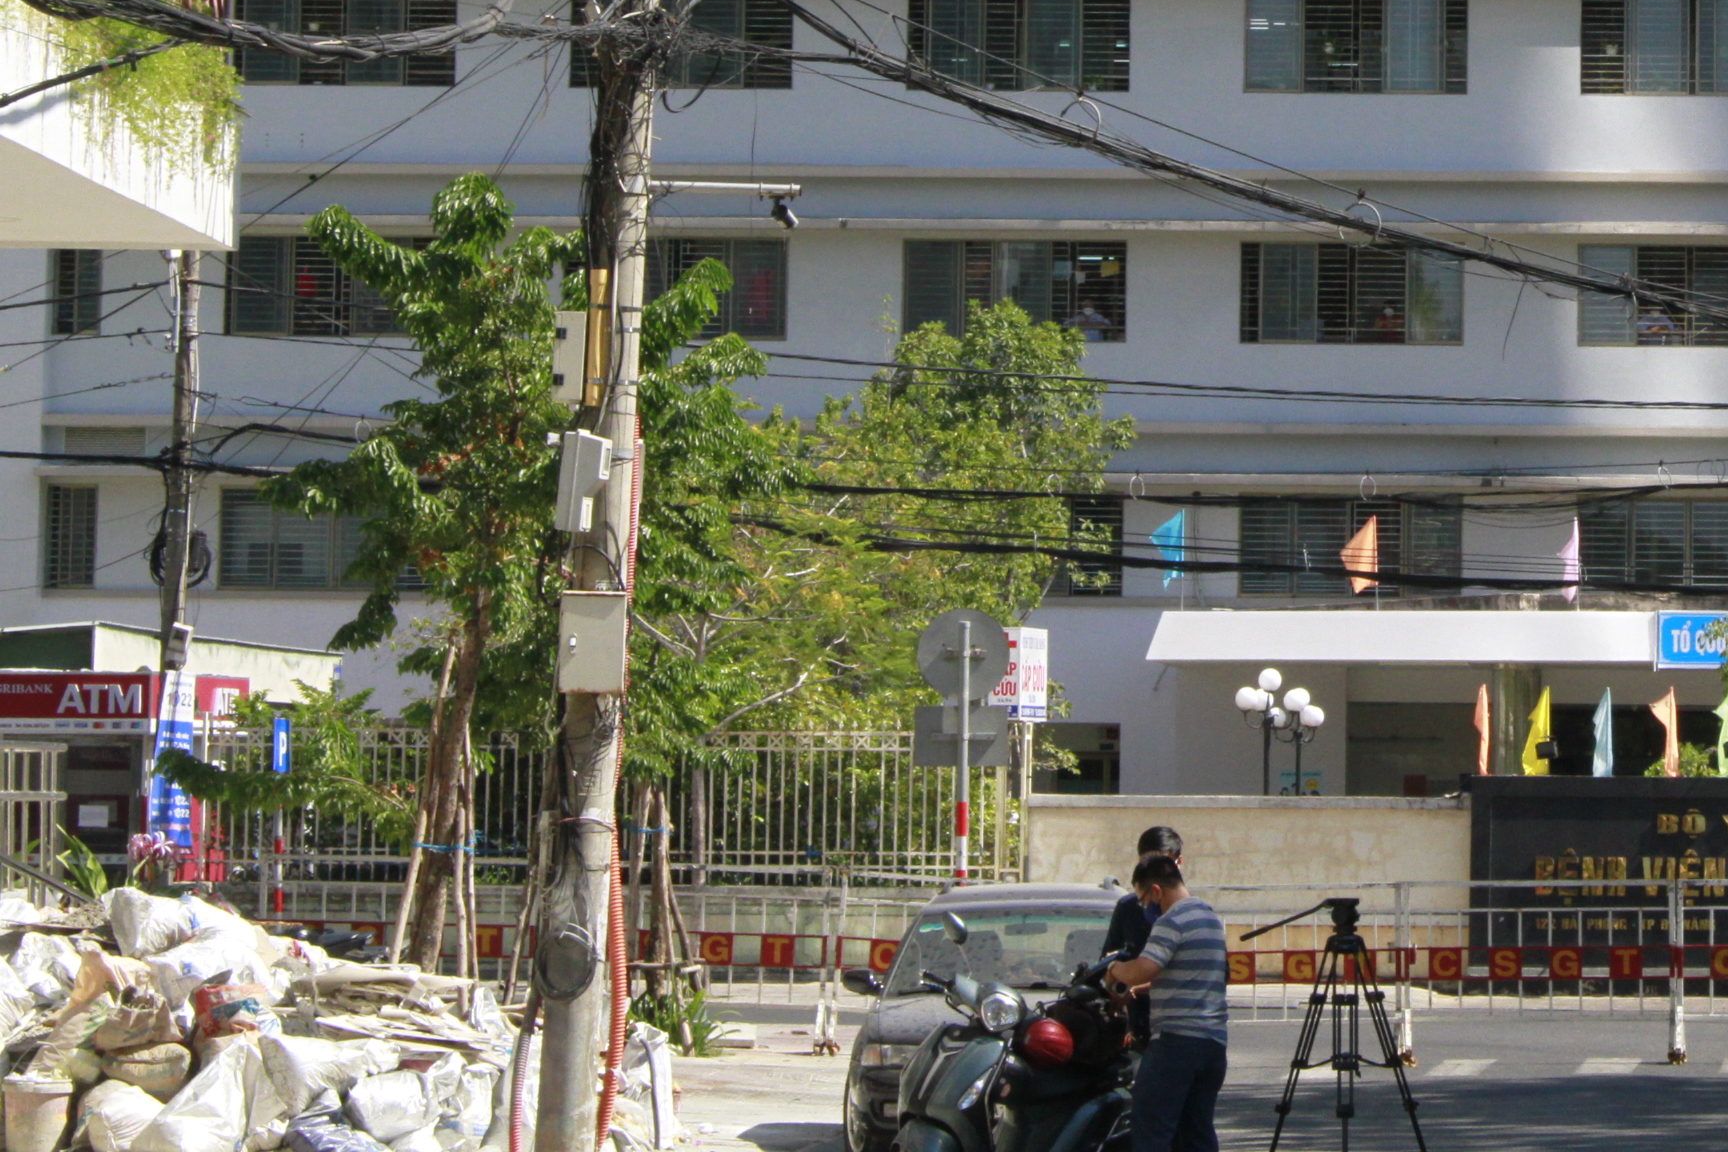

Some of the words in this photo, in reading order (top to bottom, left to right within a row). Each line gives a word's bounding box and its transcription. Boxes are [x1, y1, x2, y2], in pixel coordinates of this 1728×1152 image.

[1671, 620, 1691, 653] TỔ
[57, 683, 142, 715] ATM
[279, 731, 287, 766] P
[1657, 809, 1706, 839] BỘ
[1535, 848, 1627, 906] BỆNH
[1642, 848, 1726, 906] VIỆN
